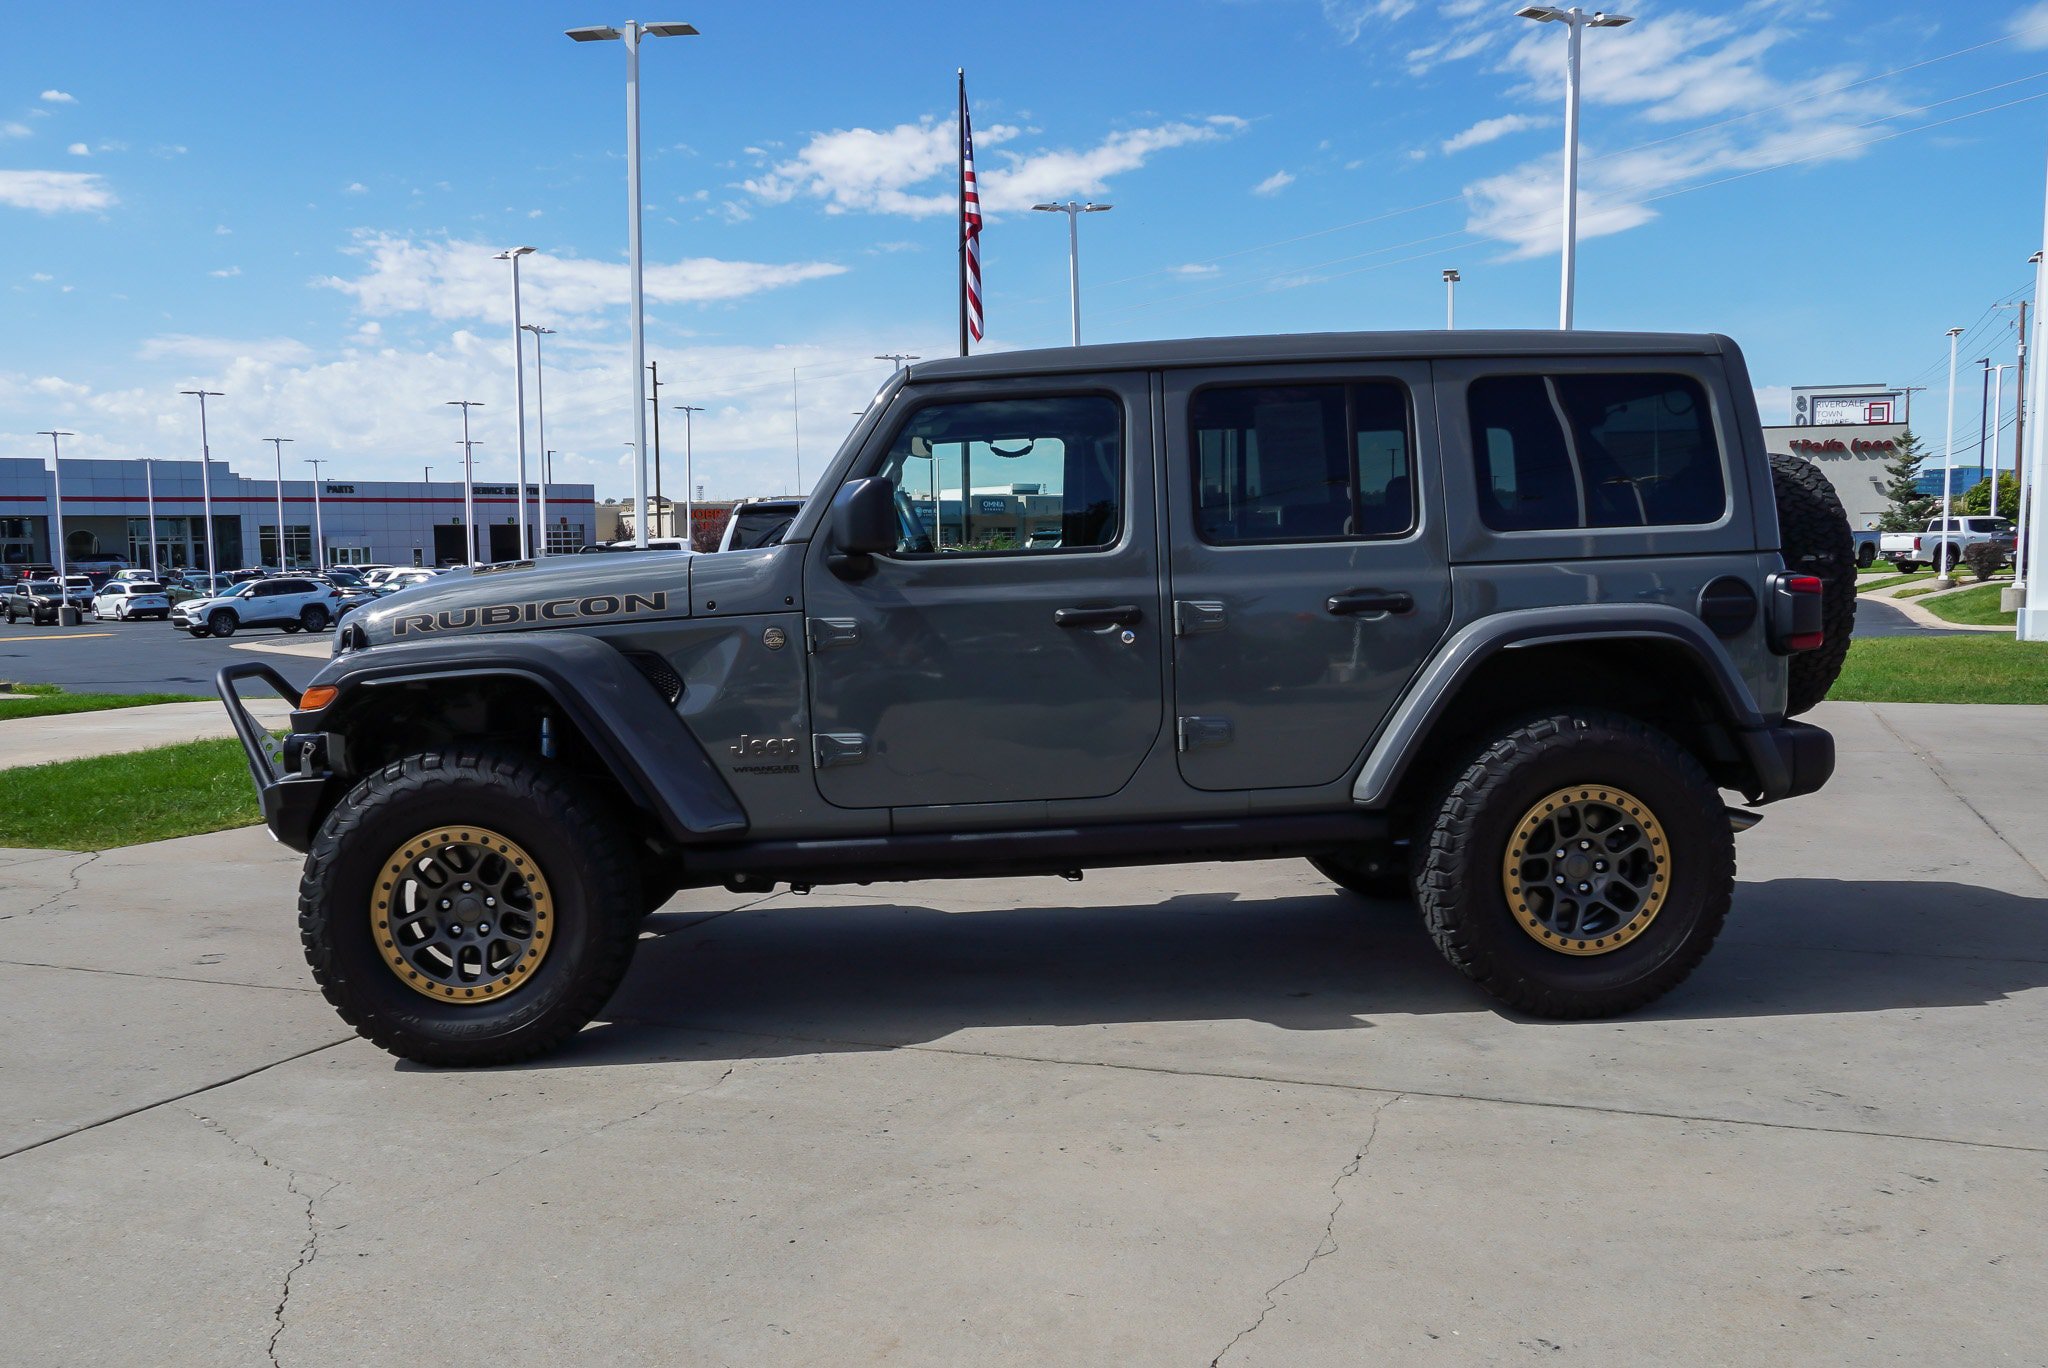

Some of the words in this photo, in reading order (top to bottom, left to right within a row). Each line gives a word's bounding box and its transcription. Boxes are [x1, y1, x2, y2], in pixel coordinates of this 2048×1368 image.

[1816, 399, 1866, 409] RIVERDALE
[1816, 410, 1843, 418] TOWN
[326, 485, 355, 494] PARTS
[393, 591, 667, 636] RUBICON
[730, 734, 799, 757] Jeep
